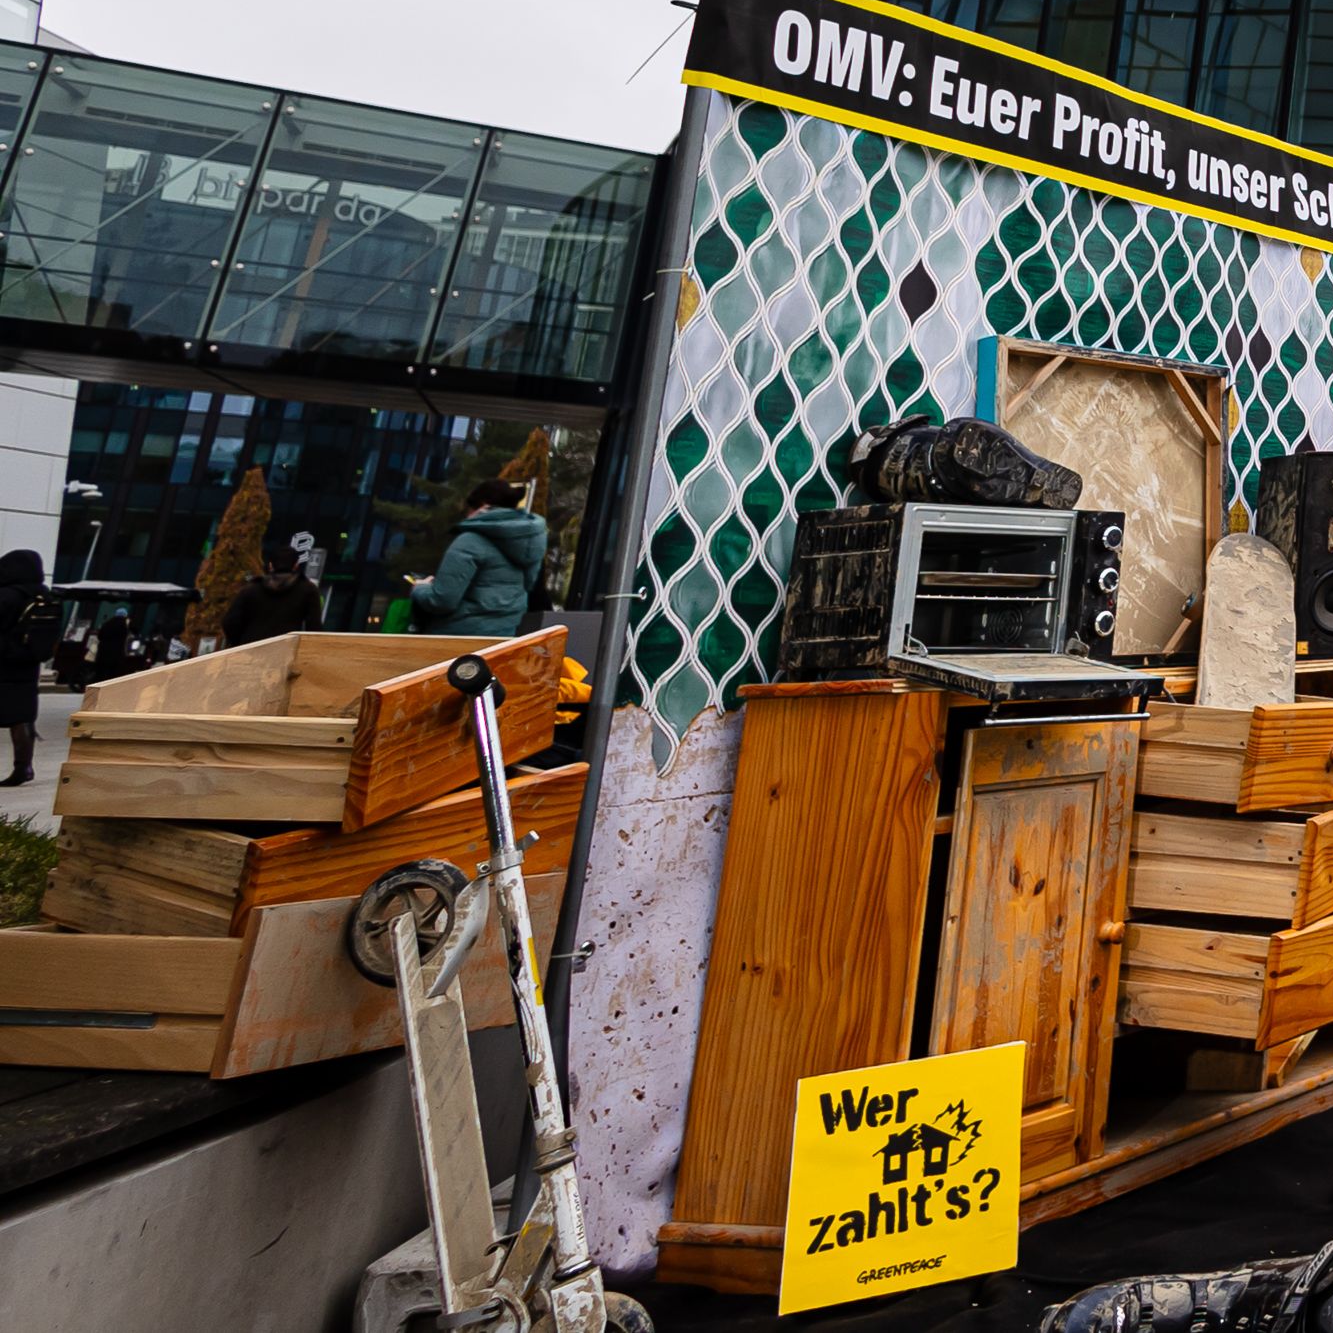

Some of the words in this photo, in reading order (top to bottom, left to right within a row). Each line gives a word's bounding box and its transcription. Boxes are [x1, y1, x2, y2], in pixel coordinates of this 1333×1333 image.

[773, 9, 916, 107] OMV:
[929, 55, 1043, 141] Euer
[1053, 93, 1177, 191] Profit,
[1187, 147, 1286, 213] unser
[819, 1086, 919, 1135] Wer
[806, 1168, 1001, 1255] zahlt's?
[857, 1255, 947, 1285] GREENPEACE
